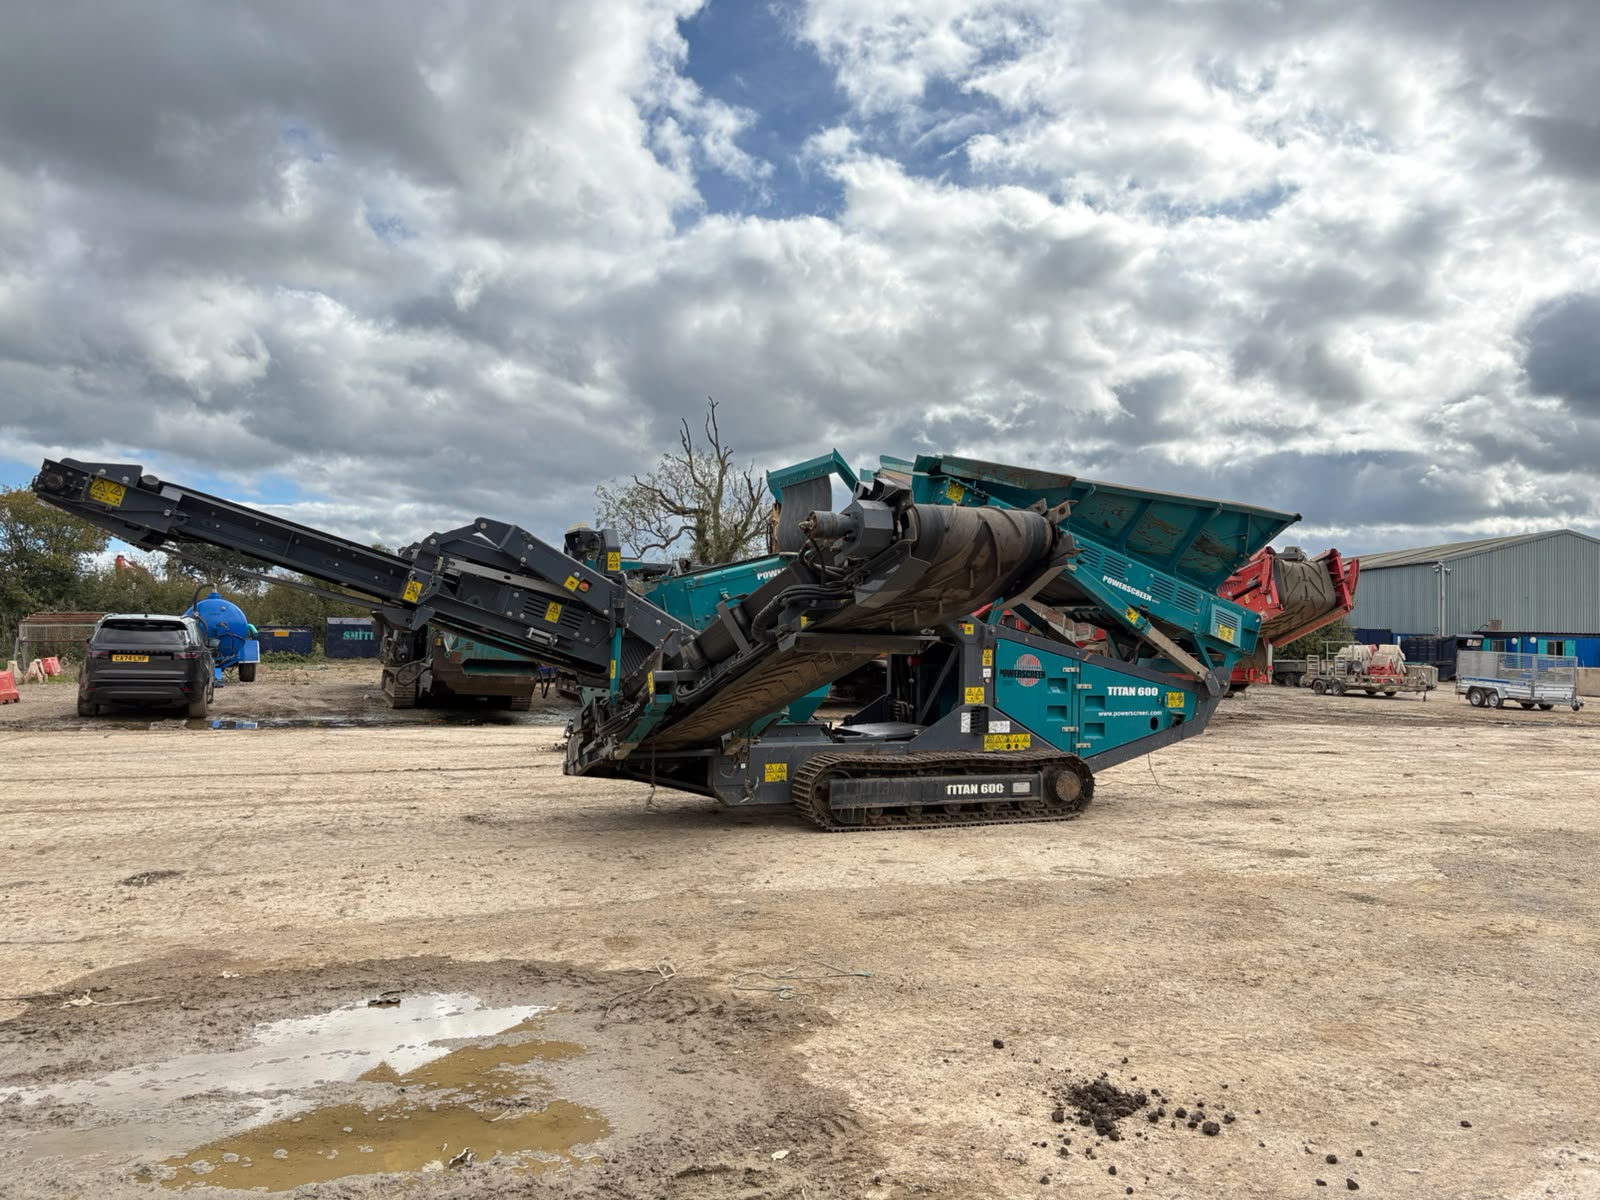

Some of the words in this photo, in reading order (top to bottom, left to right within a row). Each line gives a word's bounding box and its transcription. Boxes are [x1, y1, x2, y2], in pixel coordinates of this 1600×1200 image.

[1102, 574, 1153, 602] POWERSCREEN
[999, 668, 1046, 679] POWERSCREEN
[1107, 686, 1136, 697] TITAN
[1137, 686, 1159, 697] 600
[1098, 710, 1163, 718] www.powerscreen.com
[946, 783, 978, 796] TITAN
[980, 783, 1004, 794] 600
